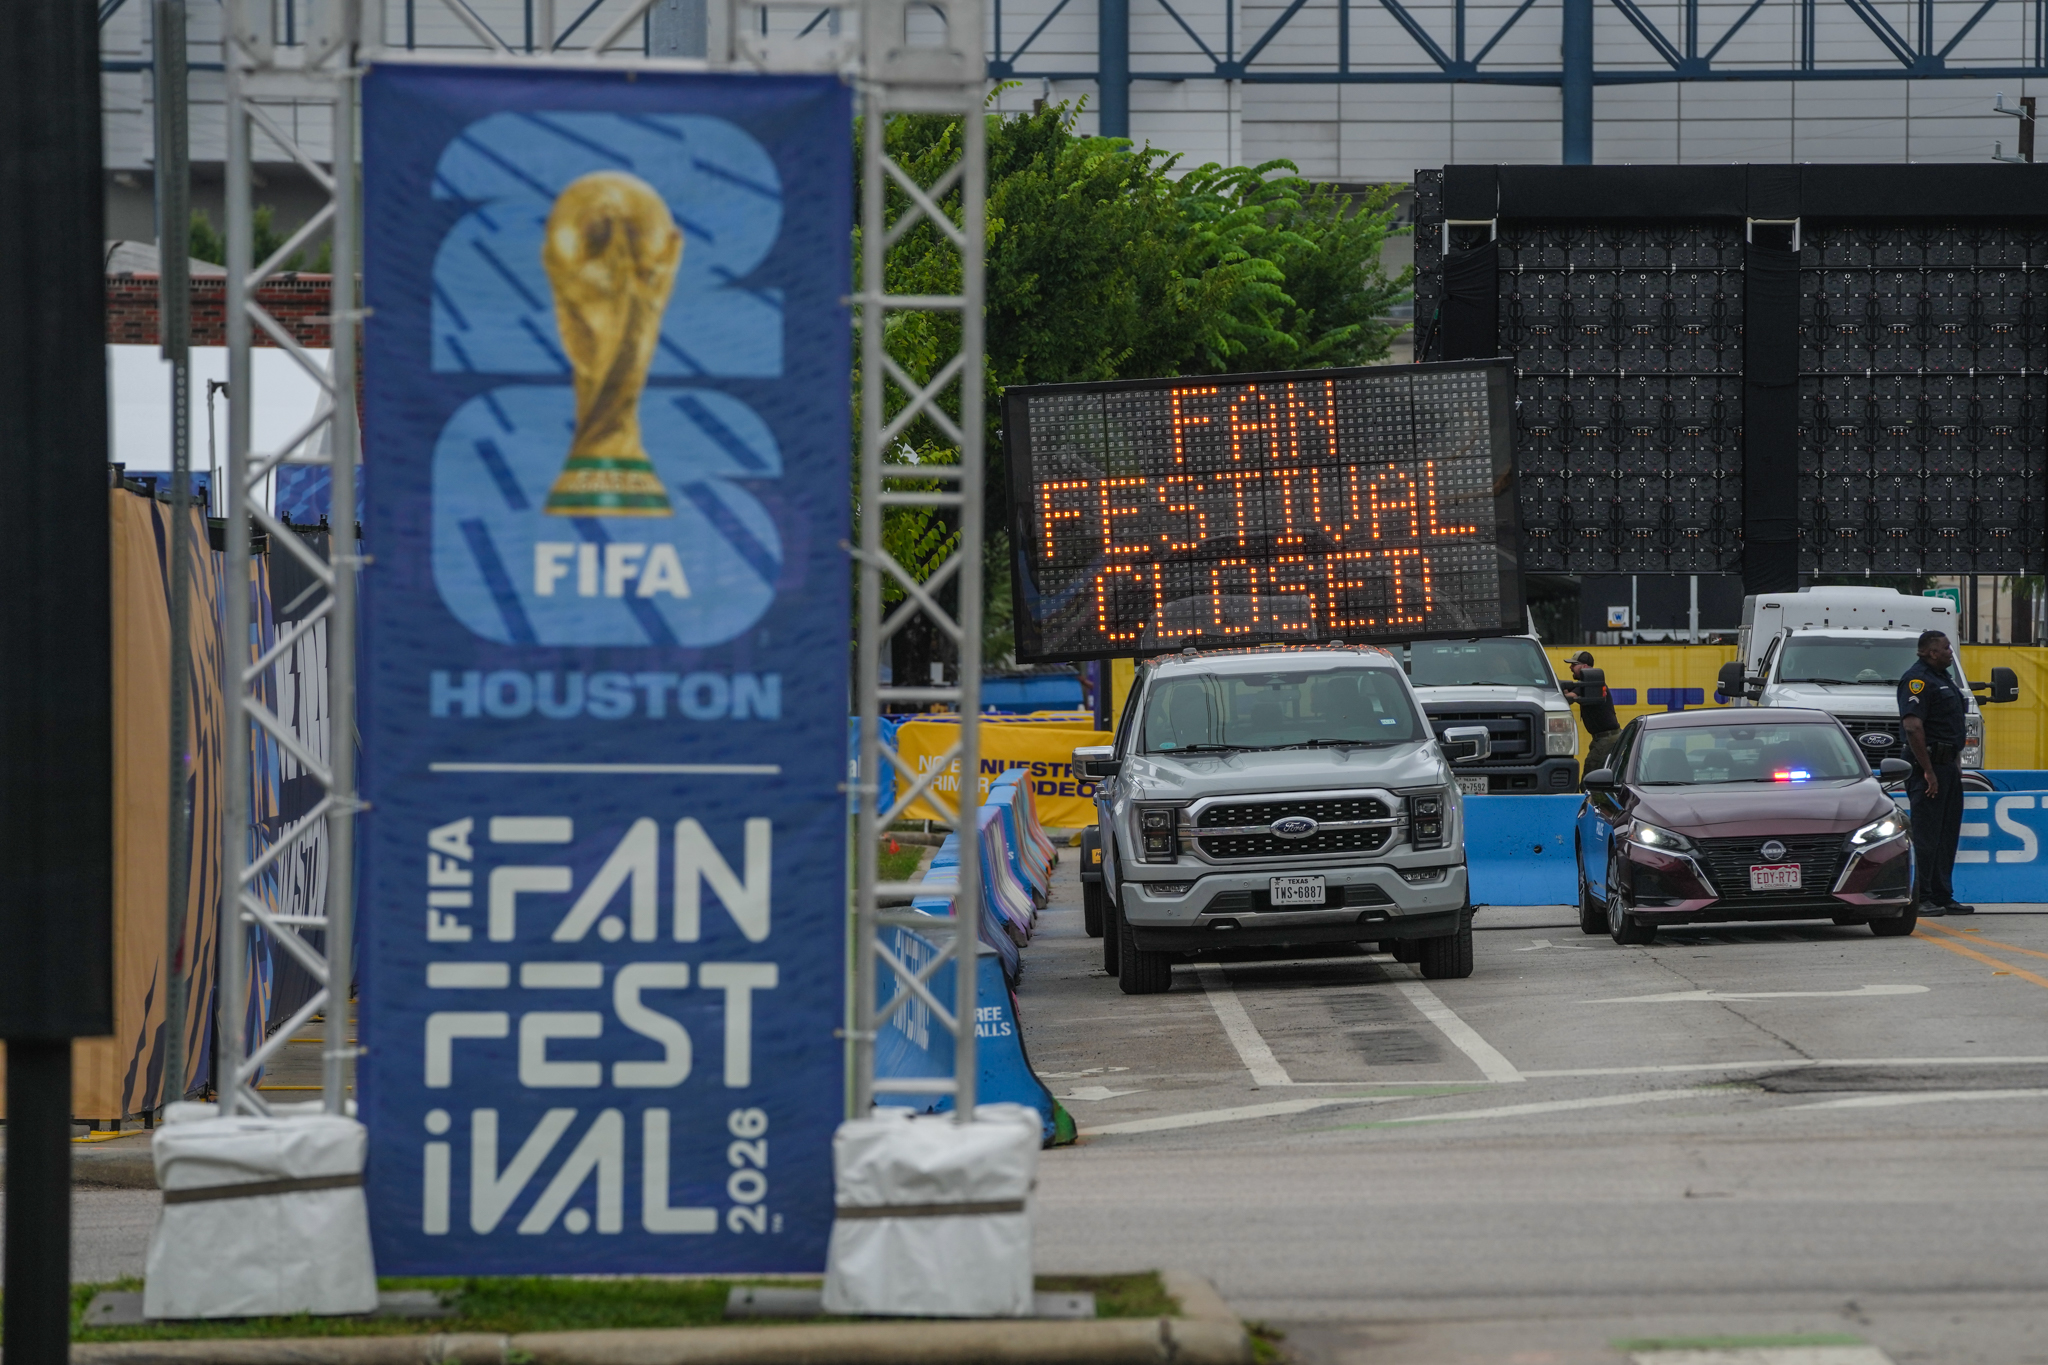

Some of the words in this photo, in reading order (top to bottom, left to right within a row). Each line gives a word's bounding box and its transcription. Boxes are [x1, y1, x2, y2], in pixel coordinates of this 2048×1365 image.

[1172, 380, 1337, 464] FAN
[1043, 461, 1477, 557] FESTIVAL
[534, 542, 692, 598] FIFA
[1096, 549, 1432, 640] CLOSED
[429, 669, 783, 720] HOUSTON
[1866, 735, 1886, 745] Ford
[1283, 821, 1307, 832] Ford
[427, 817, 474, 942] FIFA
[488, 816, 773, 943] FAN
[1757, 871, 1798, 885] EDY-R73
[424, 962, 779, 1088] FEST
[727, 1107, 769, 1234] 2026
